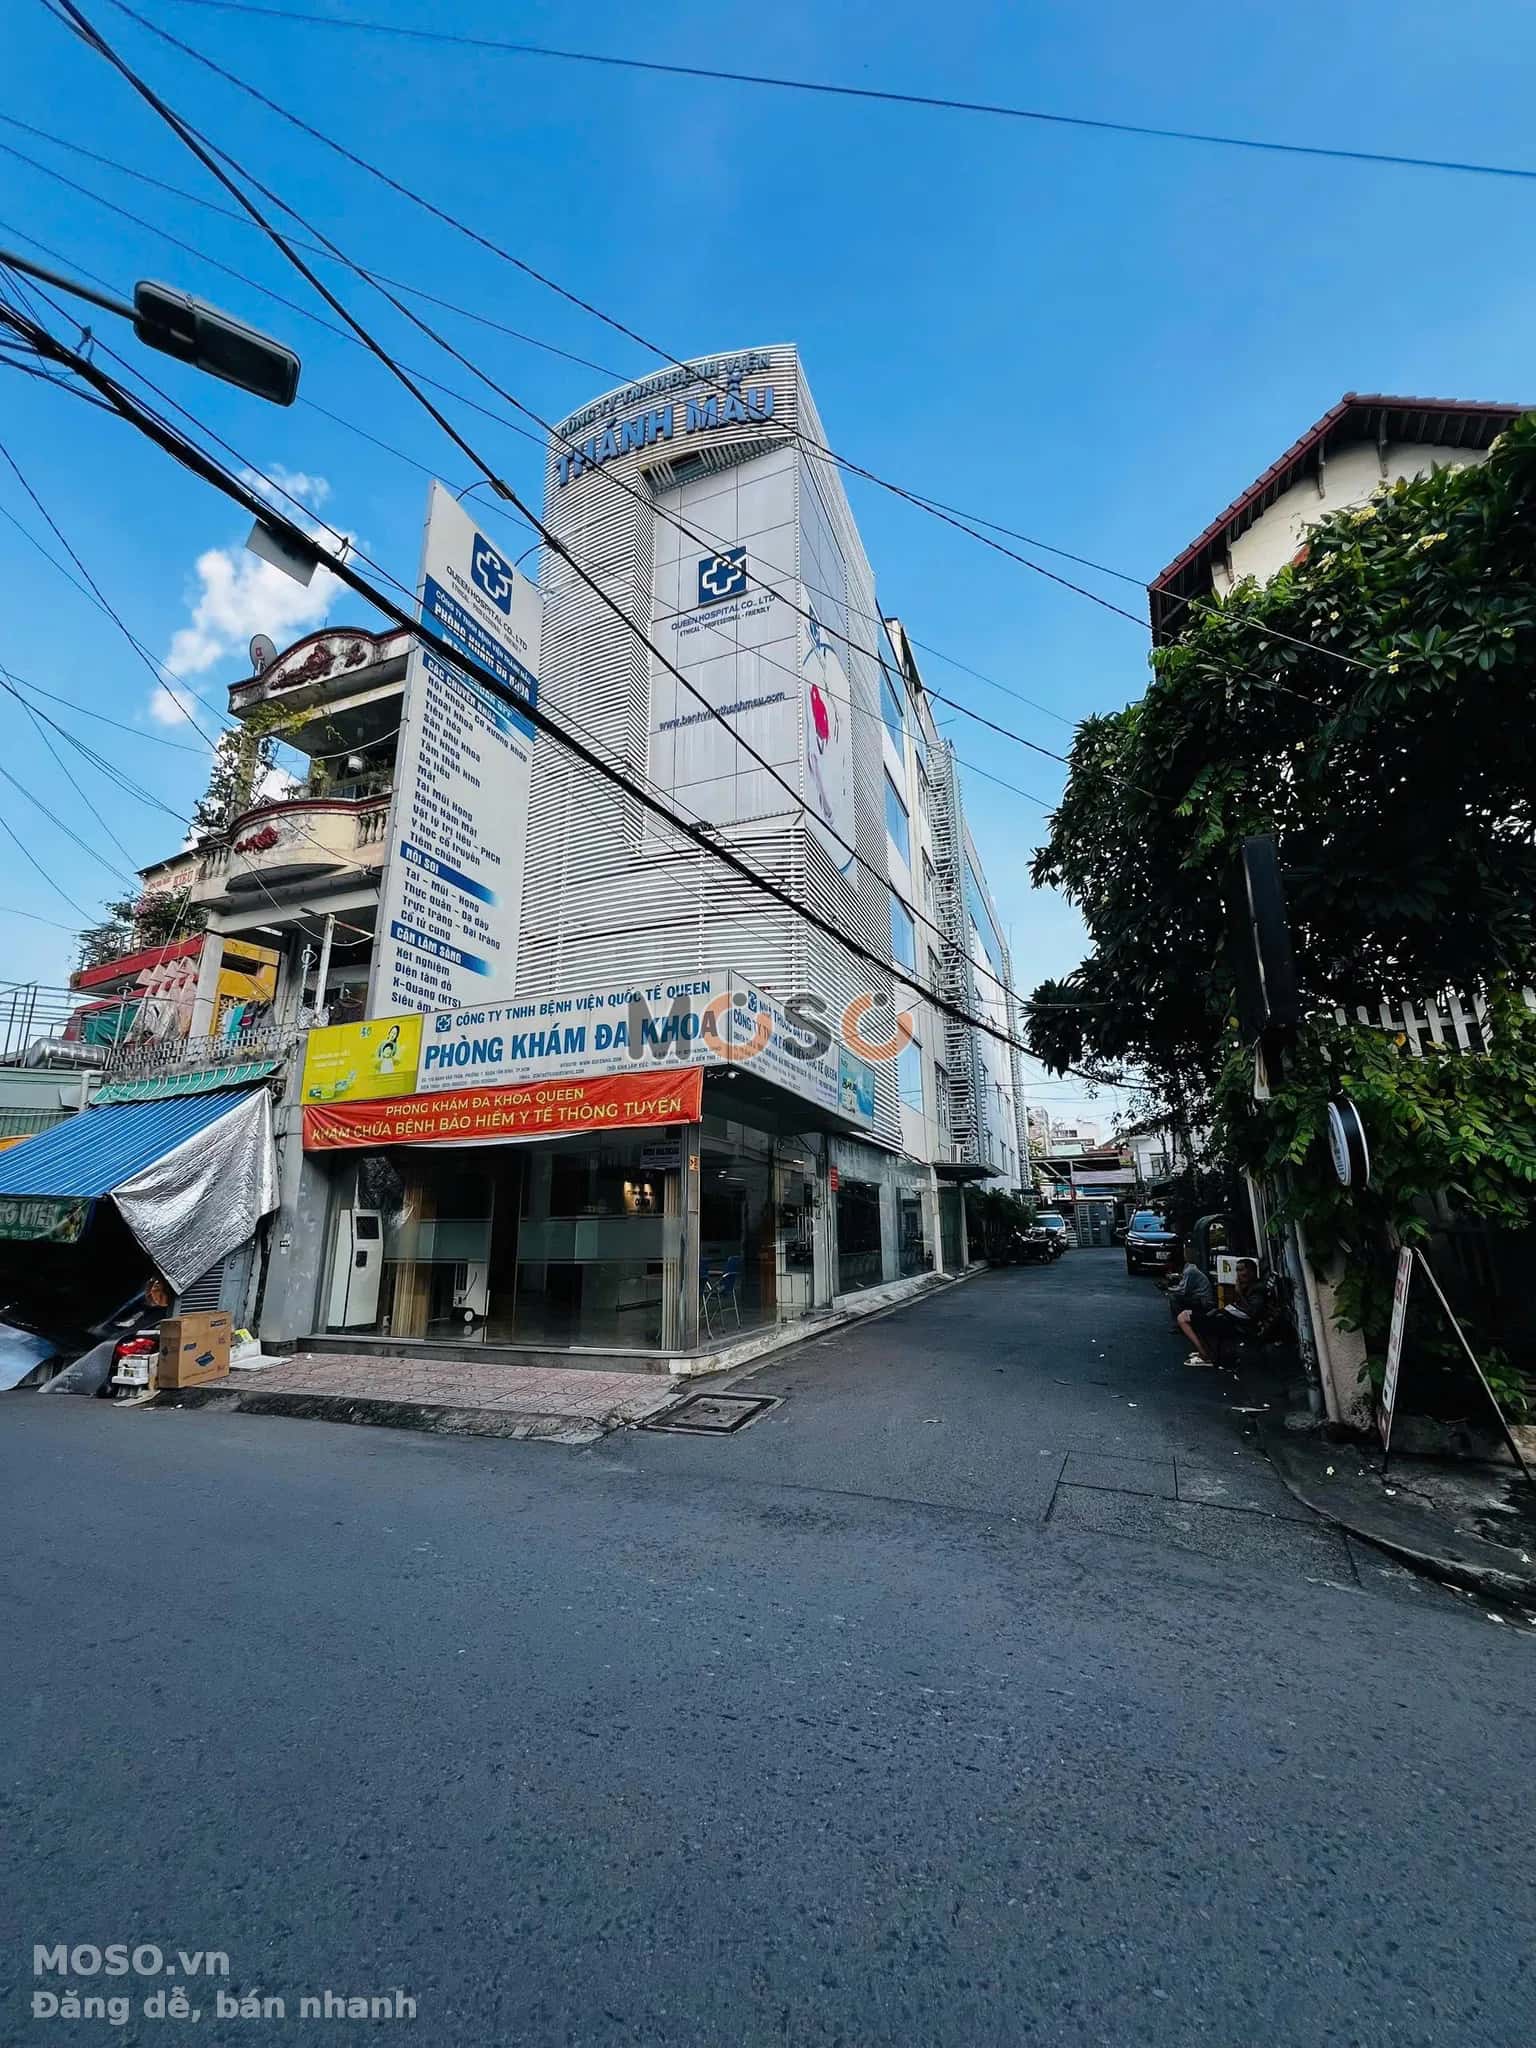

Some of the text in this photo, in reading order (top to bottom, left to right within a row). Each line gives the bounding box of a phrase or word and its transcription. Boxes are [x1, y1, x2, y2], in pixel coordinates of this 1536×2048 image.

[726, 352, 770, 374] VIỆN
[556, 372, 775, 487] THÁNH MẪU
[447, 566, 470, 593] QUEEN
[471, 592, 502, 625] HOSPITAL
[515, 634, 527, 650] LTD
[672, 616, 699, 629] QUEEN
[699, 604, 738, 621] HOSPITAL
[435, 602, 465, 641] PHÒNG
[428, 659, 444, 680] CÁC
[445, 691, 465, 712] khoa
[453, 711, 473, 731] khoa
[422, 726, 460, 759] Nhi khoa
[461, 742, 480, 762] khoa
[419, 751, 430, 766] Da
[416, 778, 429, 793] Tai
[463, 769, 480, 787] kinh
[411, 817, 417, 828] Y
[419, 823, 437, 840] học
[410, 832, 432, 851] Tiêm
[405, 847, 421, 865] NỘI
[481, 847, 500, 864] PHCN
[406, 868, 419, 881] Tai
[429, 893, 451, 912] quản
[403, 896, 425, 914] Trực
[428, 908, 452, 927] tràng
[479, 932, 500, 950] tràng
[416, 915, 426, 928] tử
[428, 923, 450, 940] cung
[396, 926, 461, 963] CẬN LÂM SÀNG
[395, 962, 417, 978] Điện
[420, 971, 438, 986] tâm
[416, 955, 449, 977] nghiệm
[392, 990, 413, 1008] Siêu
[394, 977, 435, 1001] X-Quang
[456, 980, 711, 1027] CÔNG TY TNHH BỆNH VIỆN QUỐC TẾ QUEEN
[424, 1010, 718, 1070] PHÒNG KHÁM ĐA KHOA
[734, 1008, 751, 1030] CÔNG
[817, 1057, 823, 1072] TẾ
[825, 1065, 837, 1081] QUEEN
[386, 1088, 584, 1116] PHÒNG KHÁM ĐA KHOA QUEEN
[312, 1096, 681, 1141] KHÁM CHỮA BỆNH BẢO HIỂM Y TẾ THÔNG TUYẾN
